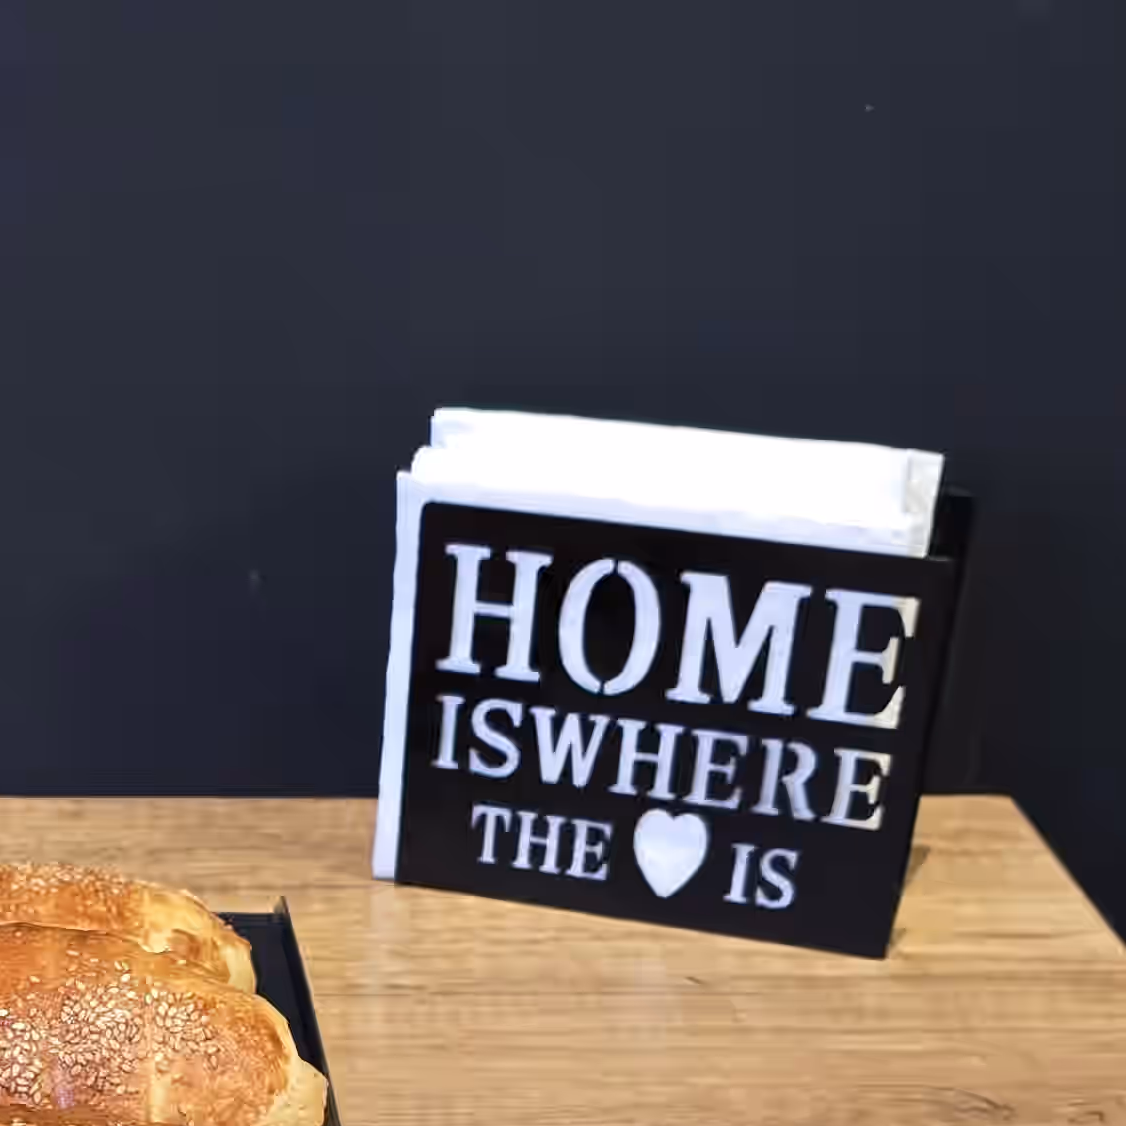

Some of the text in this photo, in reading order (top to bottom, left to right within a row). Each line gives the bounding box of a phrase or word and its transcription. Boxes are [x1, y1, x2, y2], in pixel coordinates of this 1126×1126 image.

[436, 543, 920, 729] HOME
[471, 804, 800, 909] THE IS
